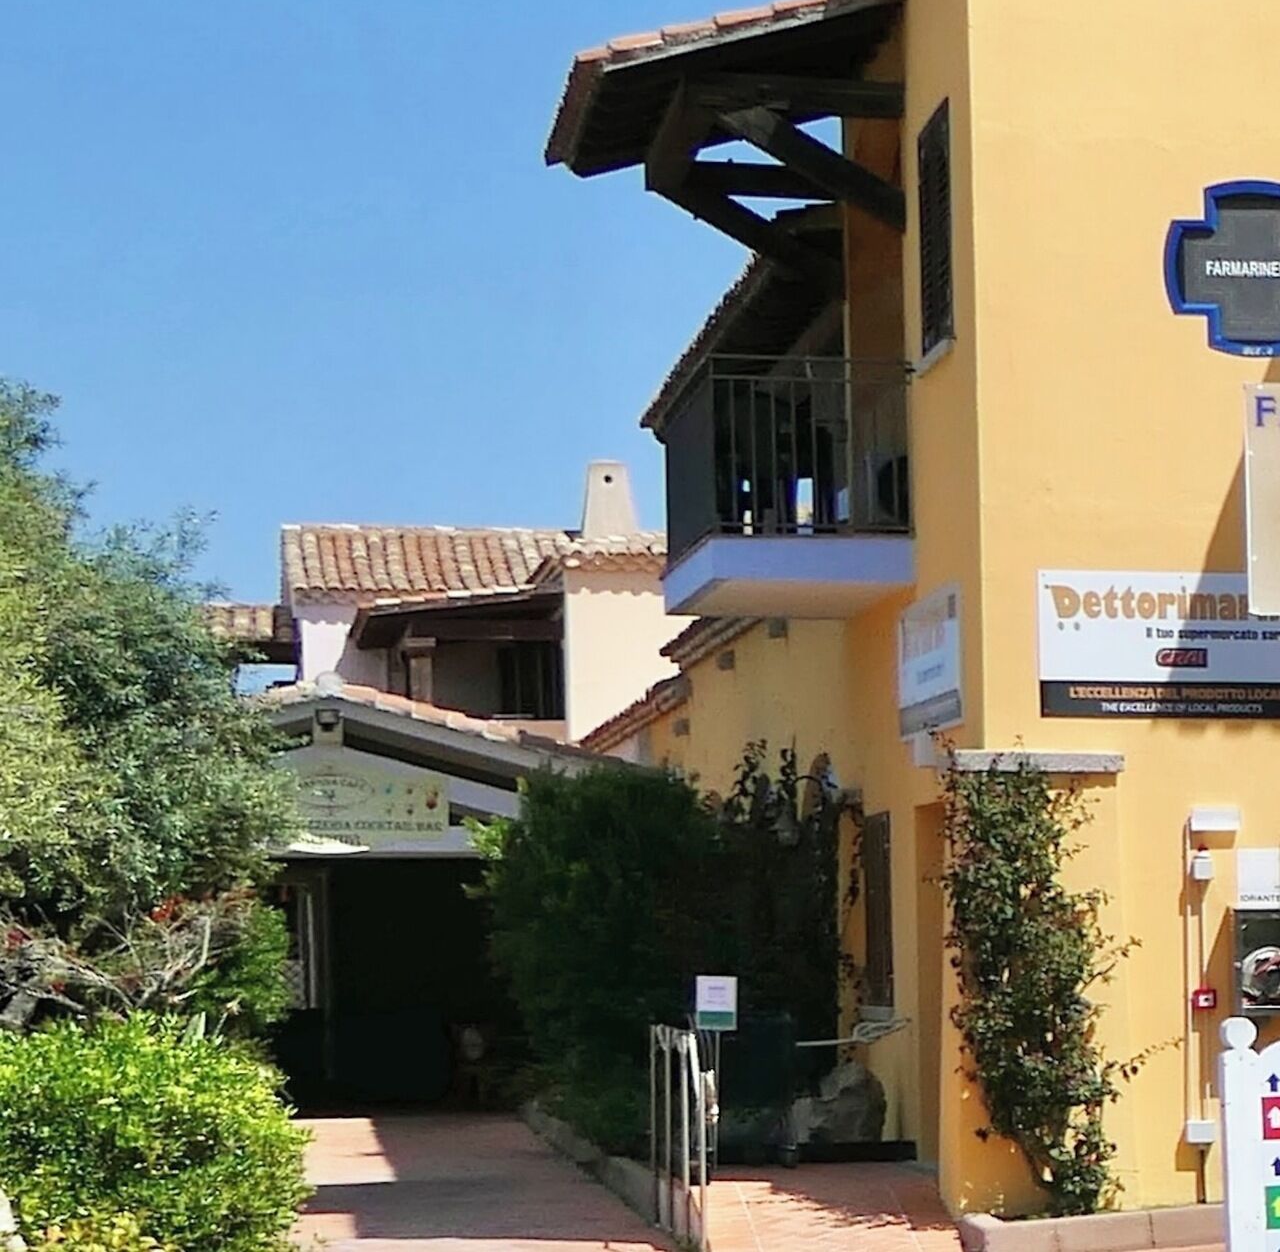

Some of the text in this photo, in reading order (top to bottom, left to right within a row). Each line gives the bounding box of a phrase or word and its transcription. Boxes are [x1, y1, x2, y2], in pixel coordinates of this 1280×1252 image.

[1156, 628, 1174, 639] tuo
[1070, 686, 1155, 699] L'ECCELLENZA
[1101, 703, 1119, 712] THE
[1188, 704, 1215, 713] LOCAL
[1217, 704, 1263, 714] PRODUCTS
